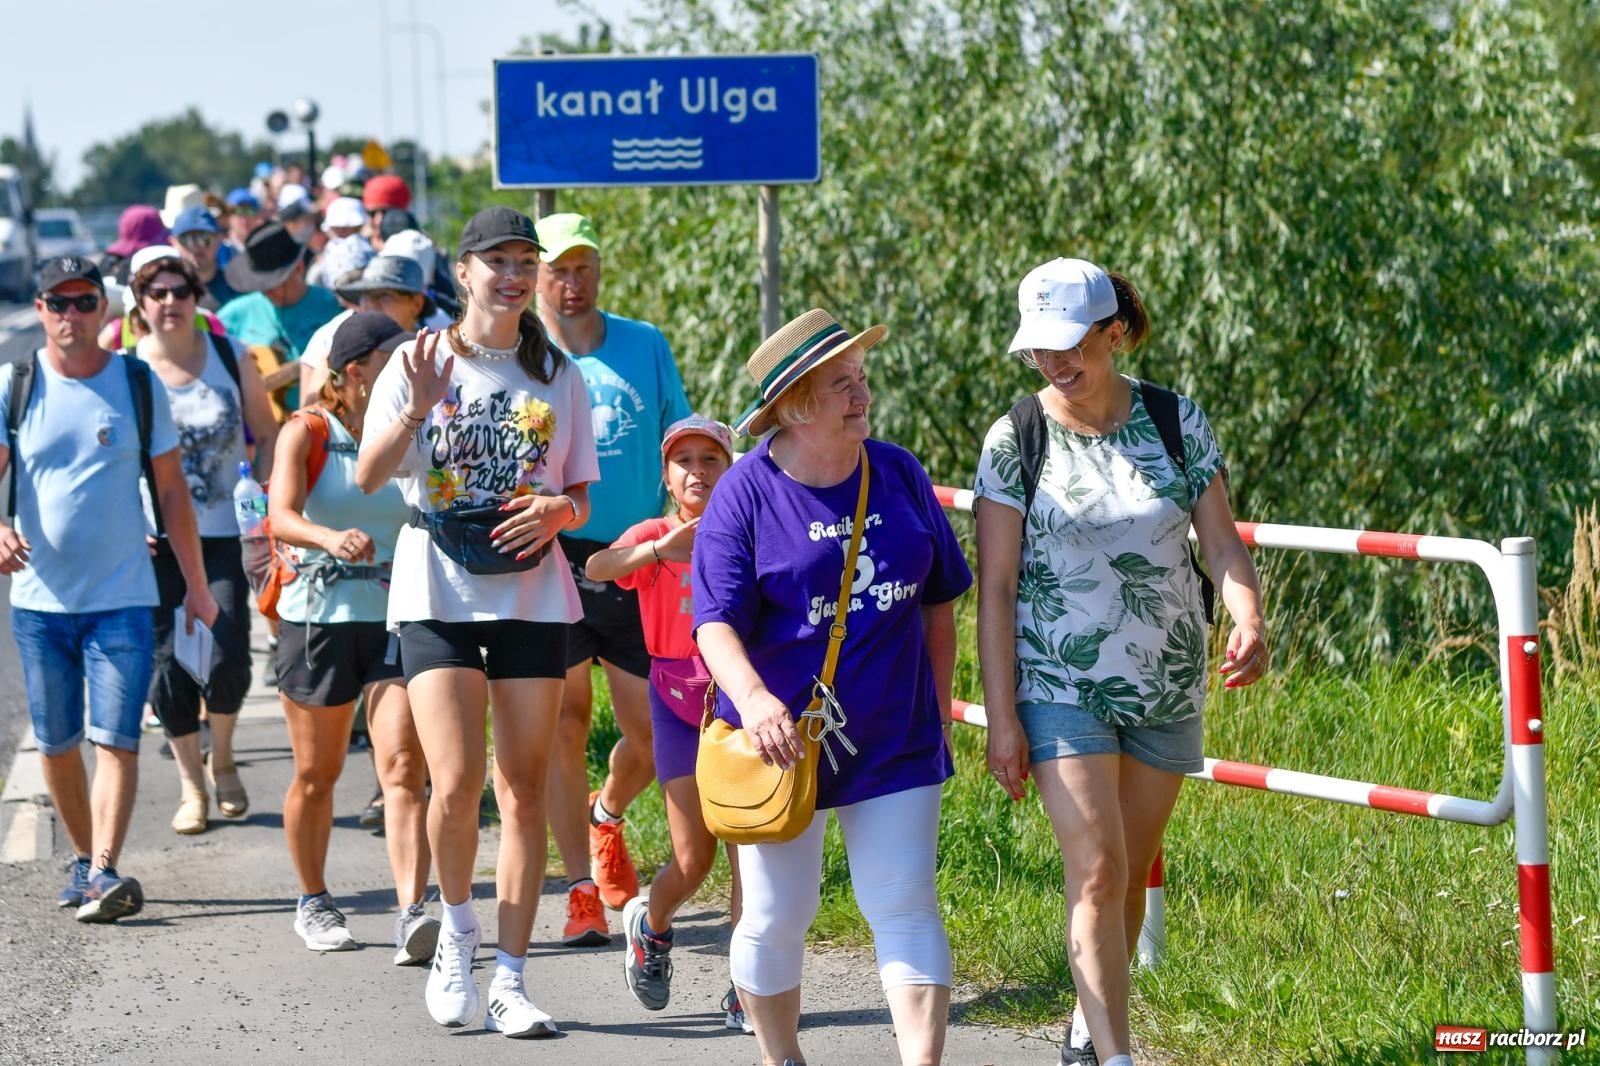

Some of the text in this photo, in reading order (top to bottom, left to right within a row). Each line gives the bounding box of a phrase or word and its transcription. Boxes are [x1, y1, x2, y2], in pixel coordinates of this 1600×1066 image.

[537, 76, 777, 123] kanał Ulga
[427, 421, 549, 470] Universe
[461, 456, 518, 495] Take
[808, 513, 883, 541] Racibrz
[840, 536, 875, 595] 5
